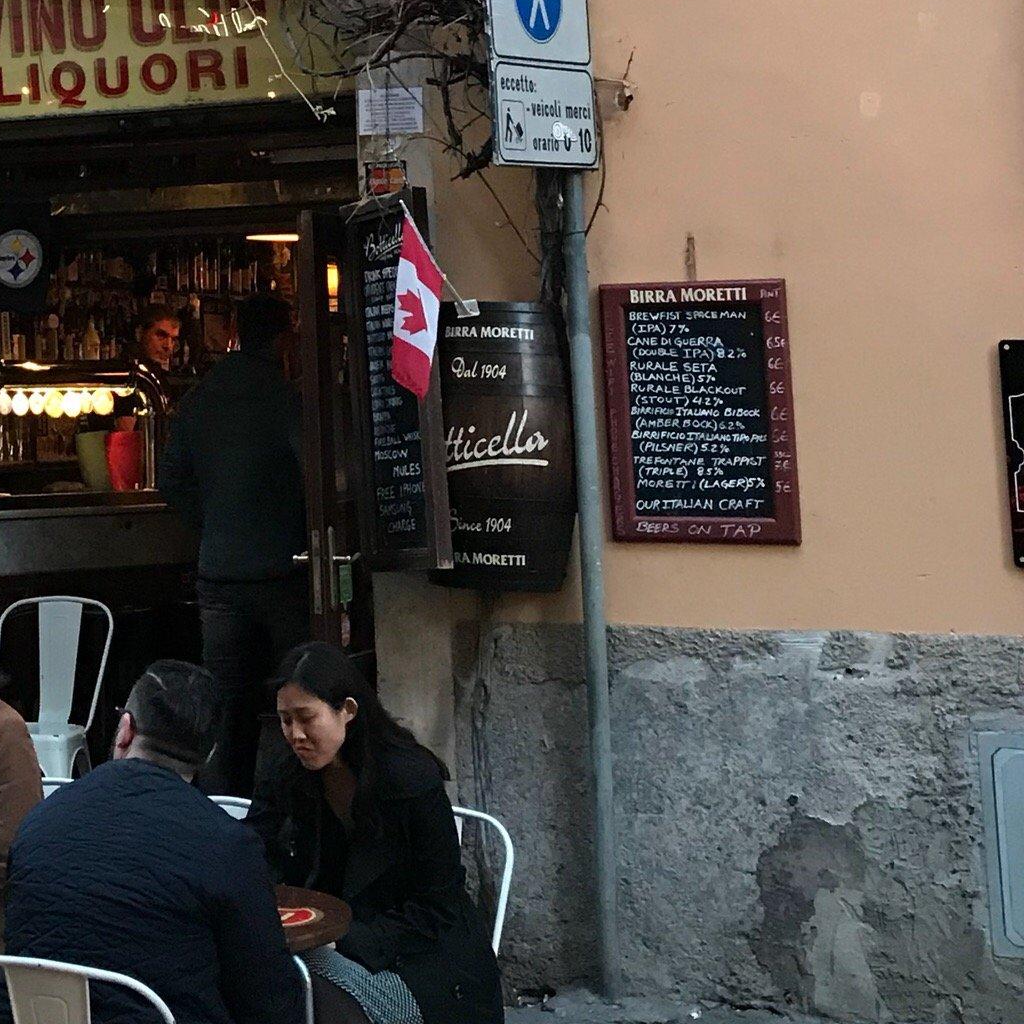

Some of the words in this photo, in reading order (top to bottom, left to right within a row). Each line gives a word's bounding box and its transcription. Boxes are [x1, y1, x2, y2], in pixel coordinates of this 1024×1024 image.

[500, 74, 537, 93] eccetto:
[565, 103, 591, 119] merci
[578, 128, 592, 153] 10
[630, 289, 677, 304] BIRRA
[681, 287, 747, 302] MORETTI
[445, 326, 477, 338] BIRRA
[480, 326, 534, 340] MORETTI
[632, 322, 666, 335] (IPA)
[627, 336, 658, 346] CANE
[674, 336, 724, 348] GUERRA
[682, 349, 714, 362] IPA)
[451, 356, 477, 378] Dal
[481, 364, 507, 379] 1904
[630, 361, 678, 372] RURALE
[683, 362, 718, 372] SETA
[630, 371, 695, 385] (BLANCHE)
[631, 383, 681, 394] RURALE
[684, 385, 747, 395] BLACKOUT
[635, 395, 690, 407] (STOUT)
[635, 417, 681, 430] (AMBER
[639, 441, 698, 455] (PILSNER)
[638, 465, 688, 479] (TRIPLE)
[662, 499, 713, 510] ITALIAN
[719, 499, 765, 511] CRAFT
[485, 517, 511, 533] 1904
[636, 521, 679, 533] BEERS
[688, 524, 712, 534] ON
[720, 524, 761, 538] TAP
[473, 553, 525, 565] MORETTI
